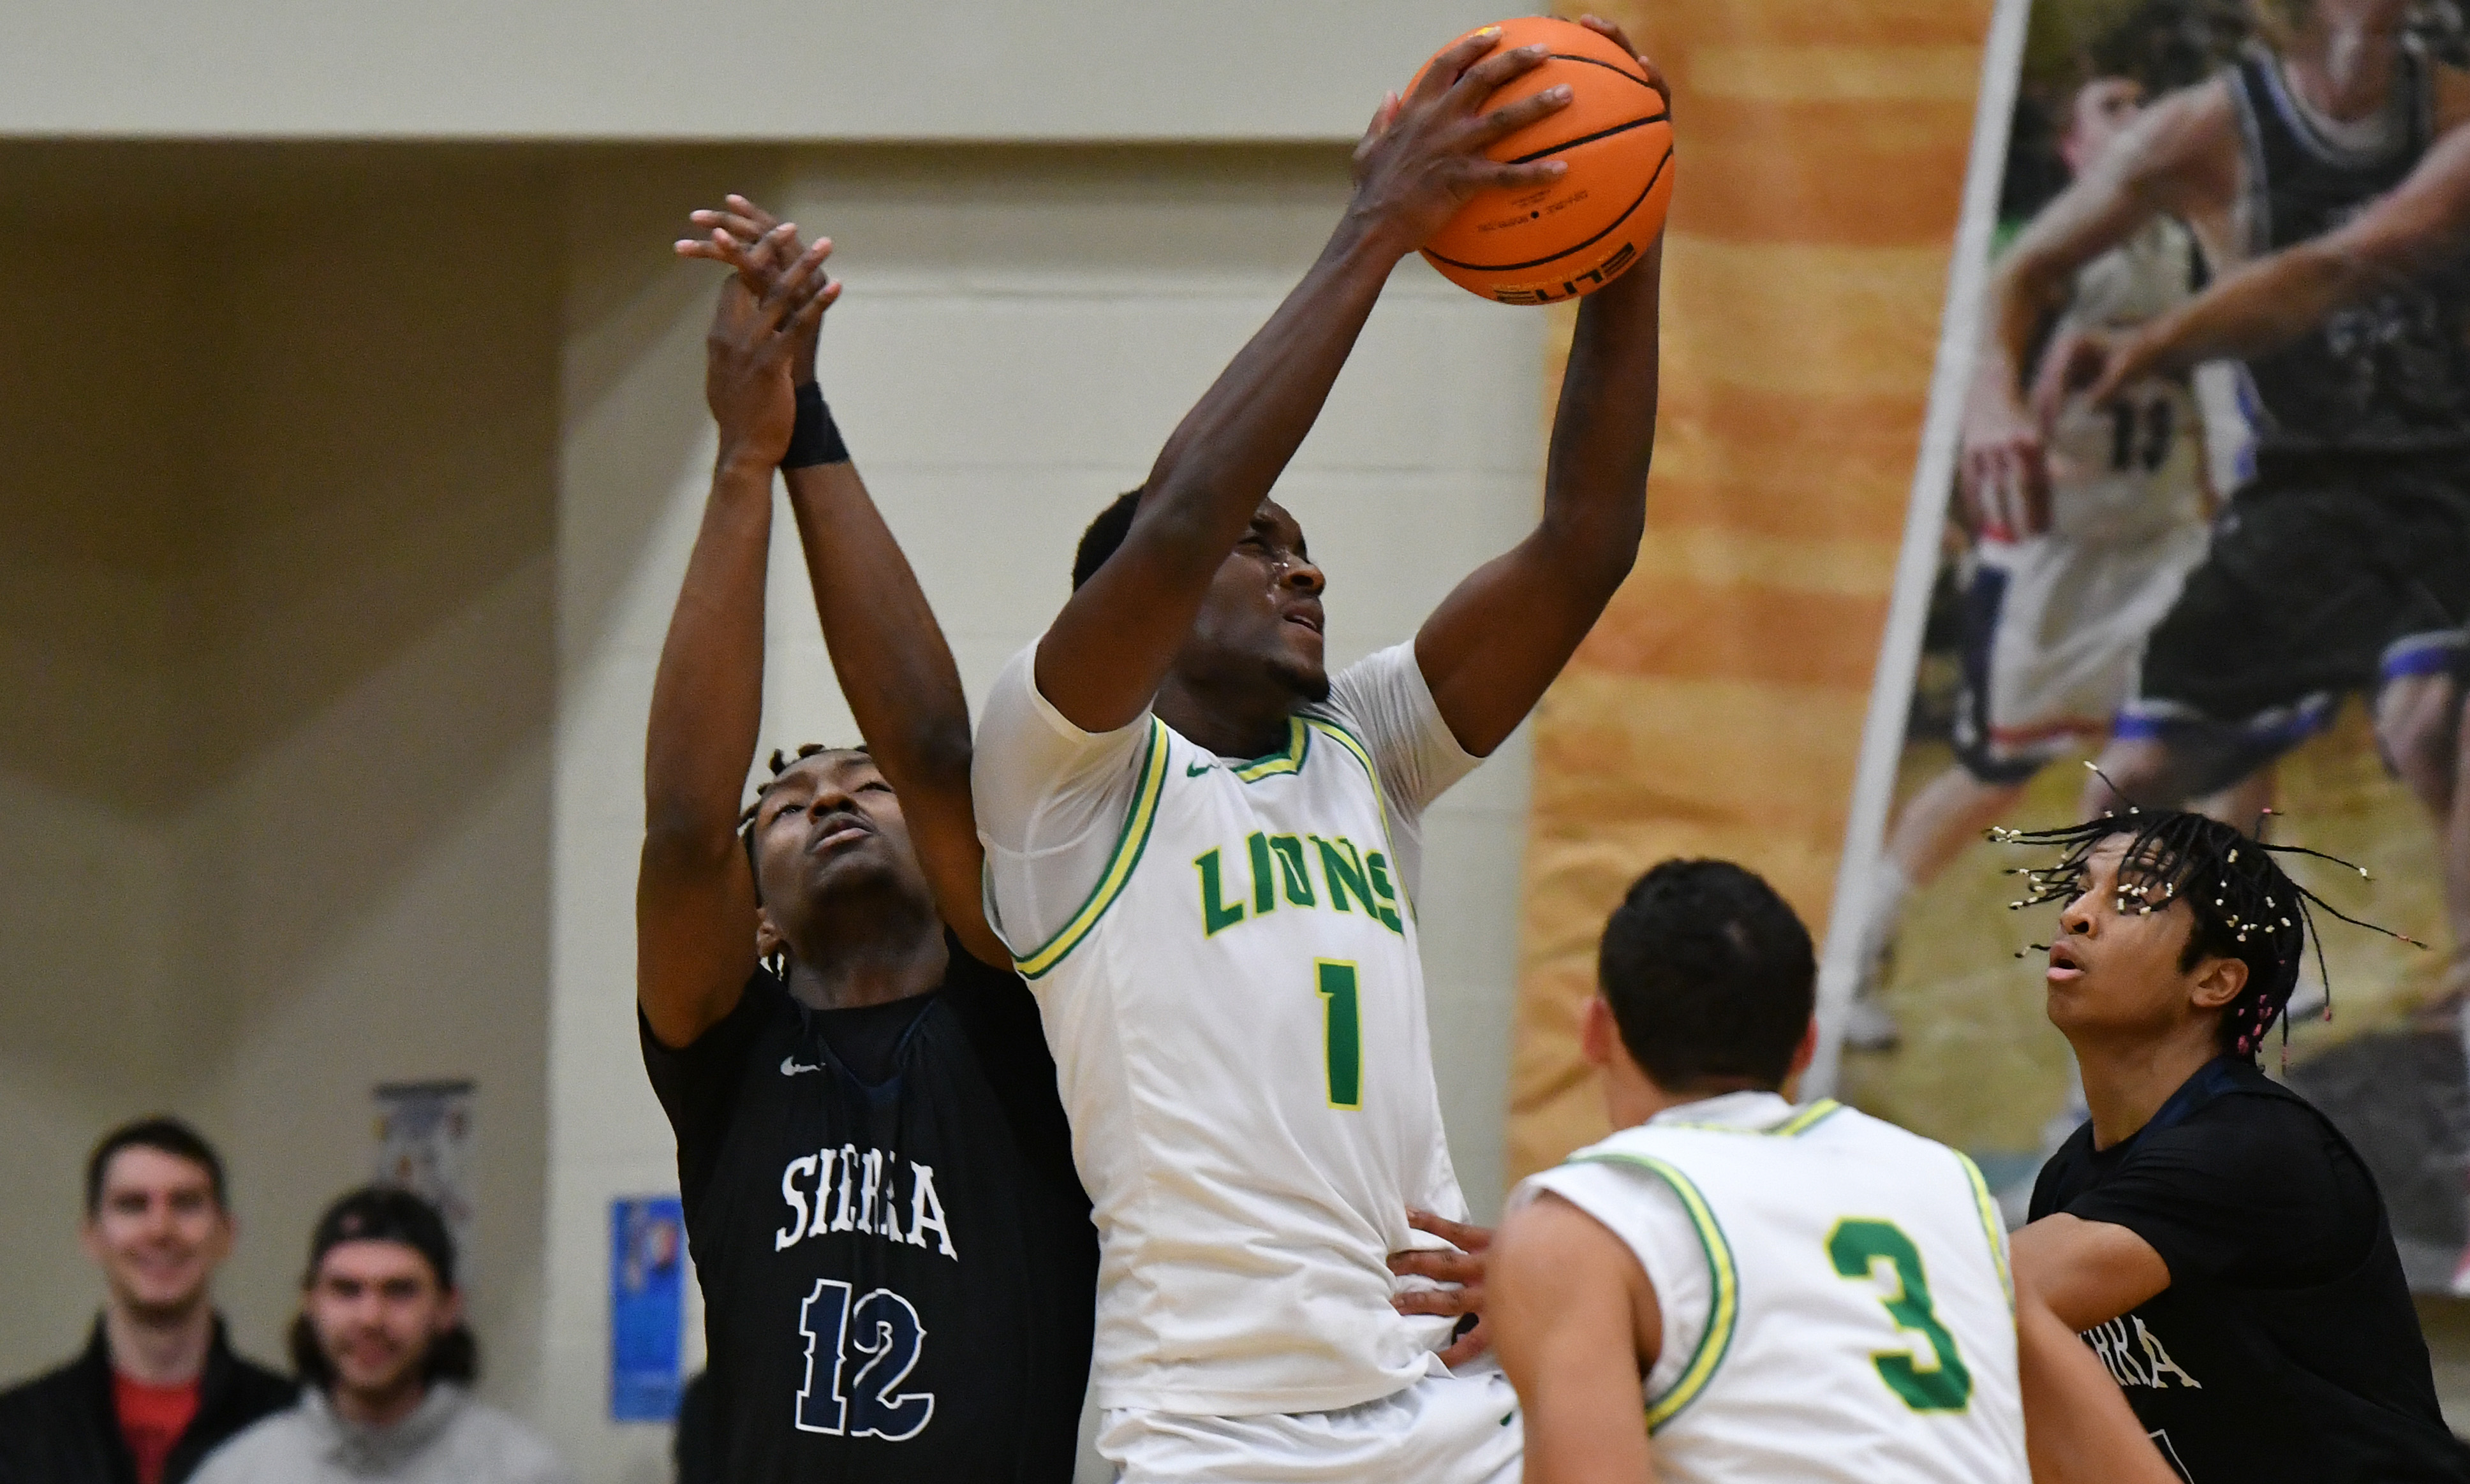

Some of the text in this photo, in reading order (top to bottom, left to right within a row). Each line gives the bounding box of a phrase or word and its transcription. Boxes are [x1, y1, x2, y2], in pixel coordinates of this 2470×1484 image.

[1493, 242, 1637, 305] ELITE
[1191, 828, 1405, 939] LIONS
[1314, 957, 1363, 1111] 1
[775, 1143, 958, 1262] SIERRA
[795, 1278, 935, 1441] 12
[1824, 1217, 1974, 1414] 3
[2077, 1314, 2203, 1389] RRA
